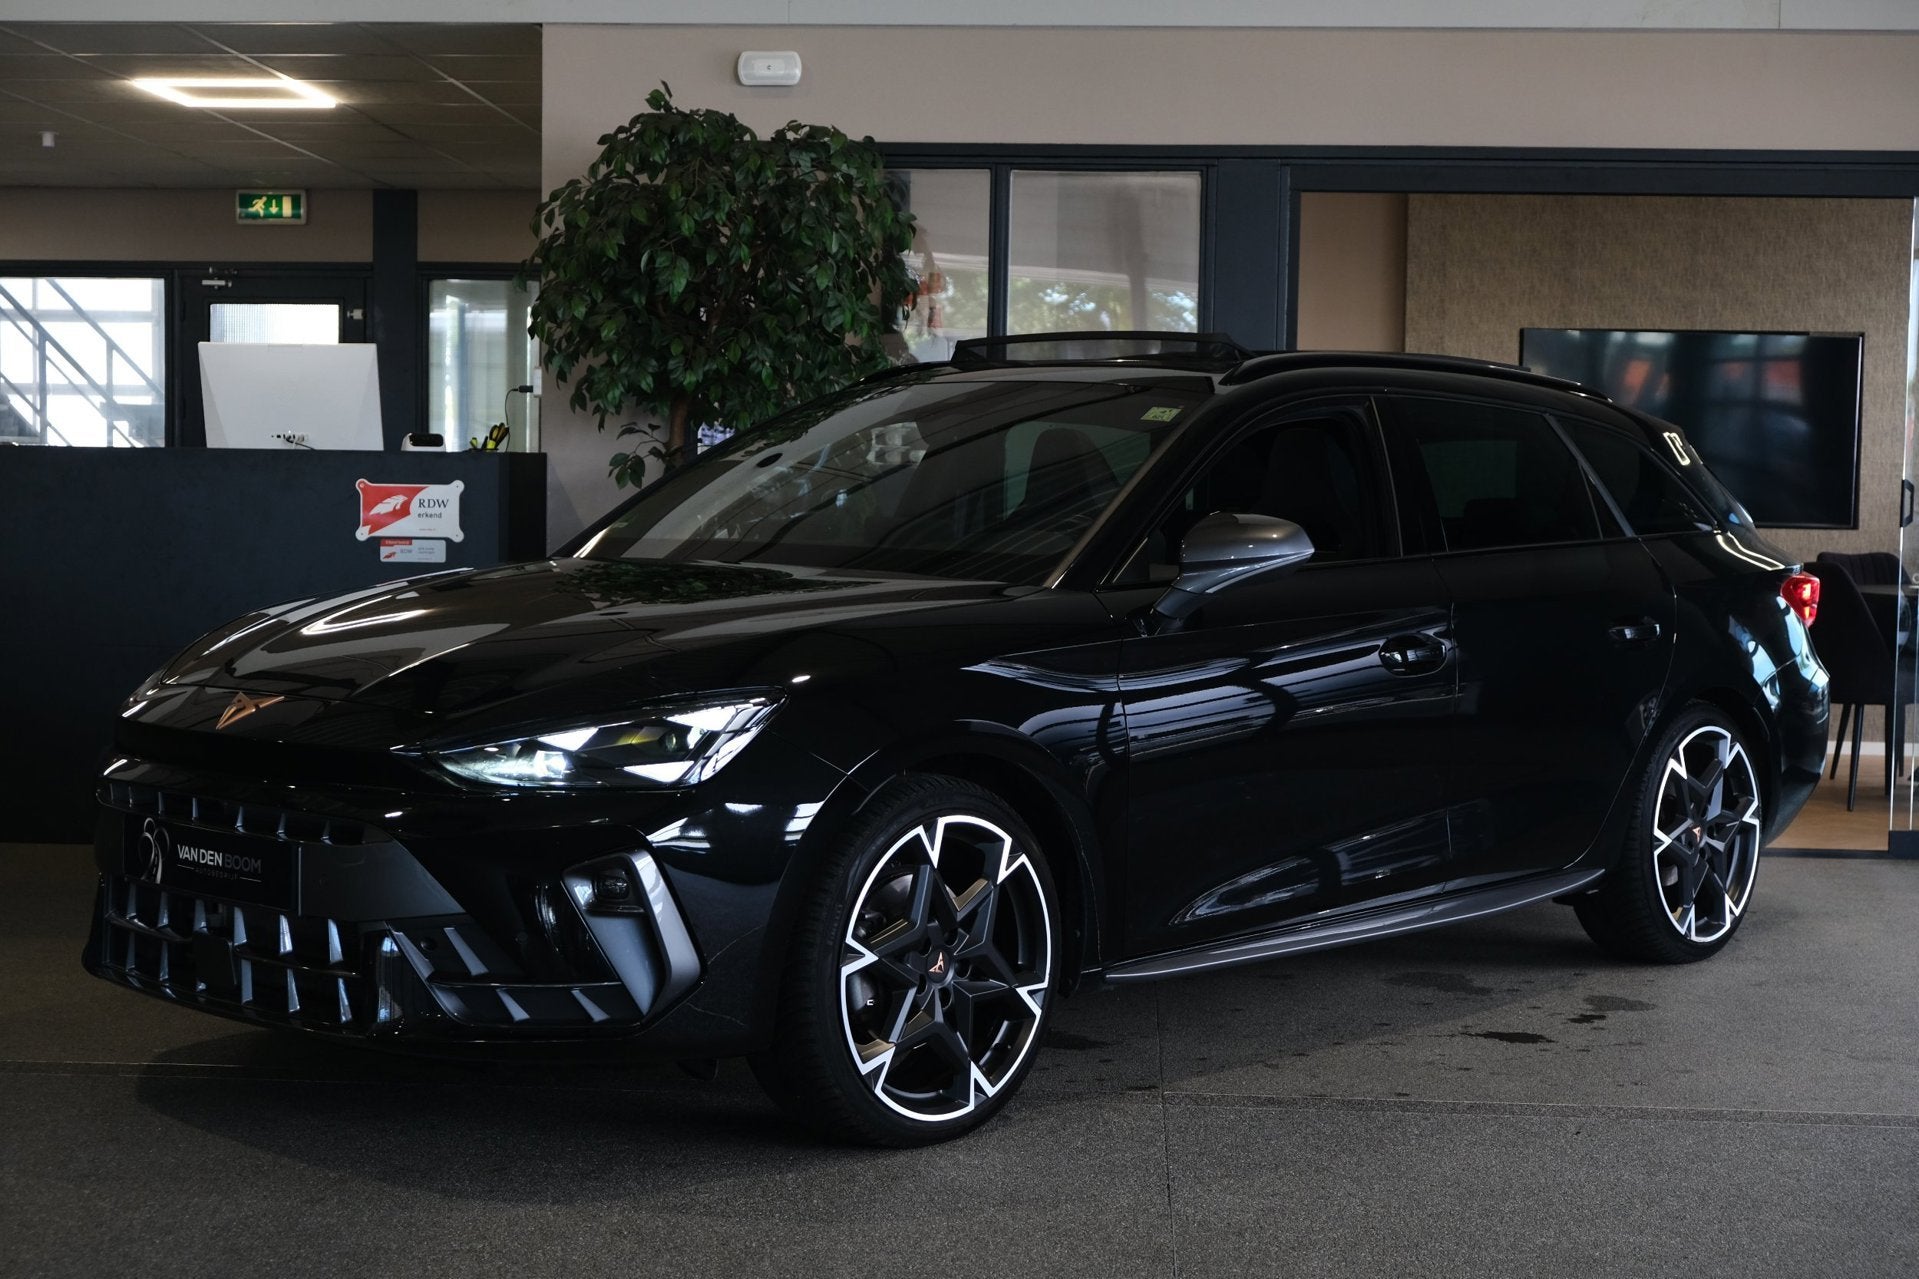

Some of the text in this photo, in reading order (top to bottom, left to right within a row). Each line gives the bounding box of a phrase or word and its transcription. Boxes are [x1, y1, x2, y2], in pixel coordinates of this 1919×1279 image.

[418, 498, 449, 509] RDW
[417, 511, 442, 519] erkend
[177, 843, 262, 874] VAN DEN BOOM
